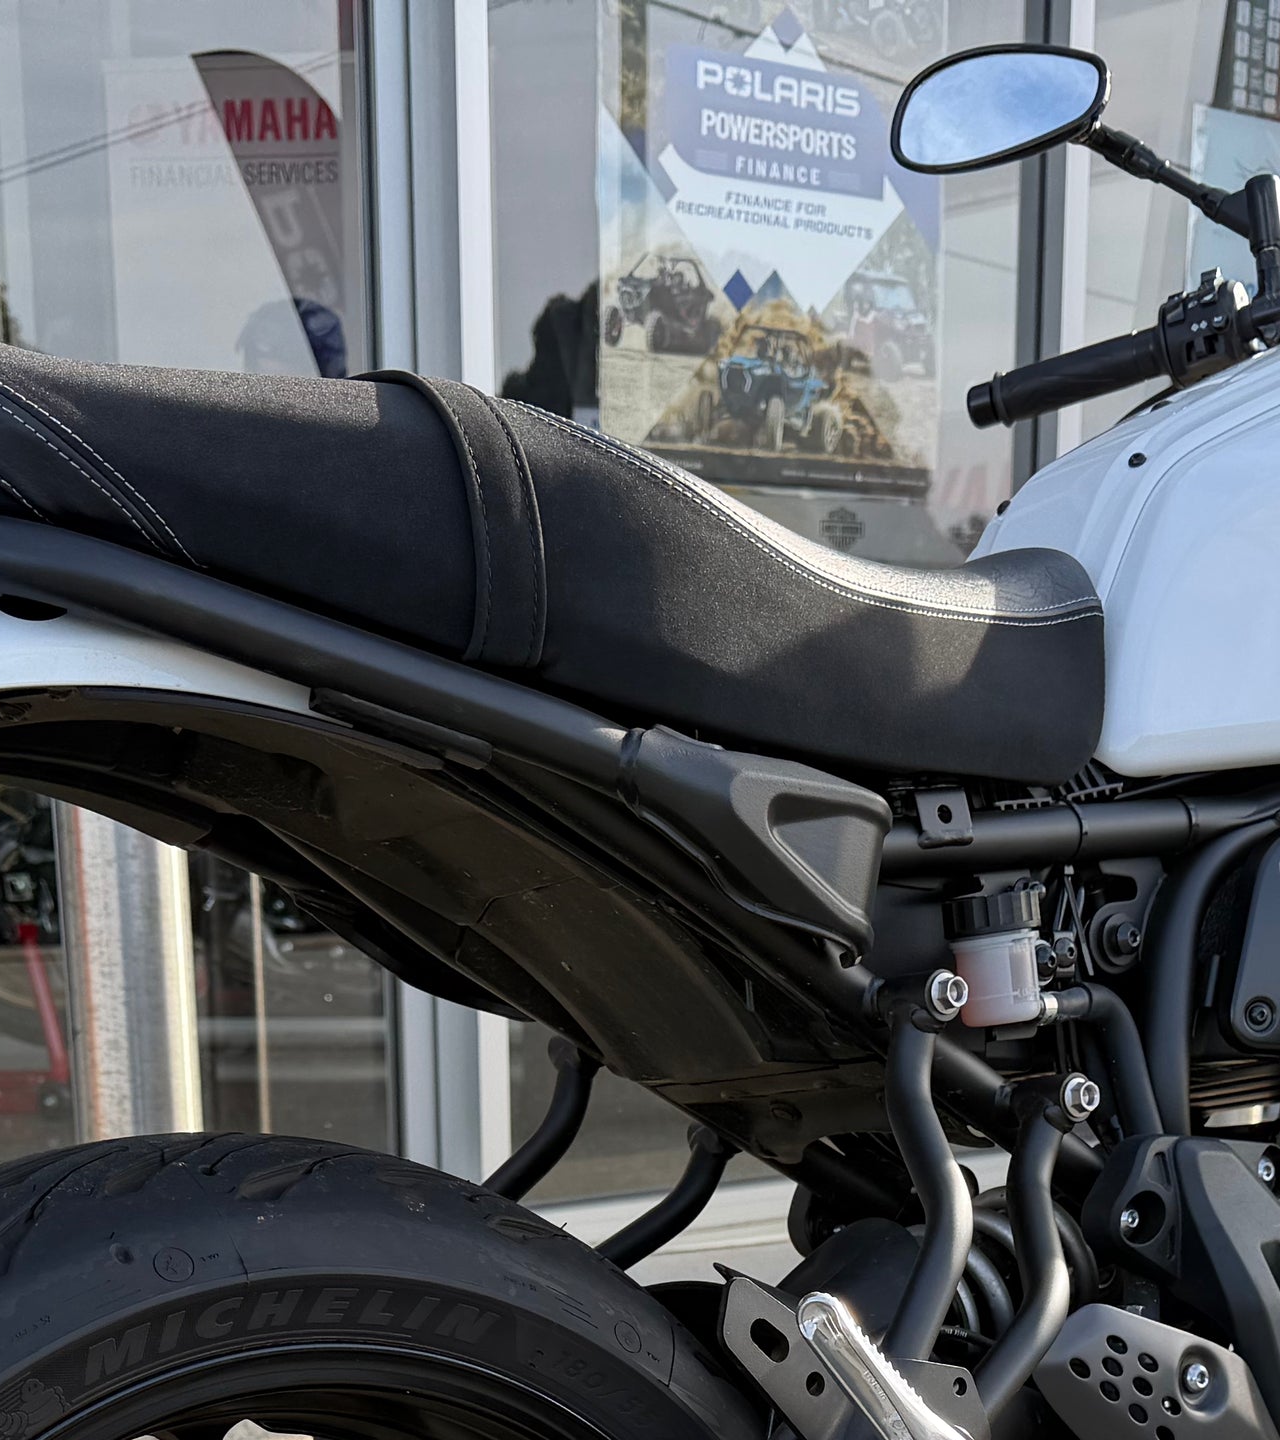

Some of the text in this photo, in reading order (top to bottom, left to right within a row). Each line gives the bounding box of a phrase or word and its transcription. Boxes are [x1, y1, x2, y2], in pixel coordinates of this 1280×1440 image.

[696, 59, 861, 118] POLARIS
[179, 98, 338, 143] YAMAHA
[701, 108, 857, 160] POWERSPORTS
[243, 160, 338, 185] SERVICES
[735, 156, 822, 186] FINANCE
[675, 199, 874, 241] RECREATIONAL PRODUCTS
[724, 190, 827, 218] FINANCE FOR
[83, 1286, 502, 1387] MICHELIN
